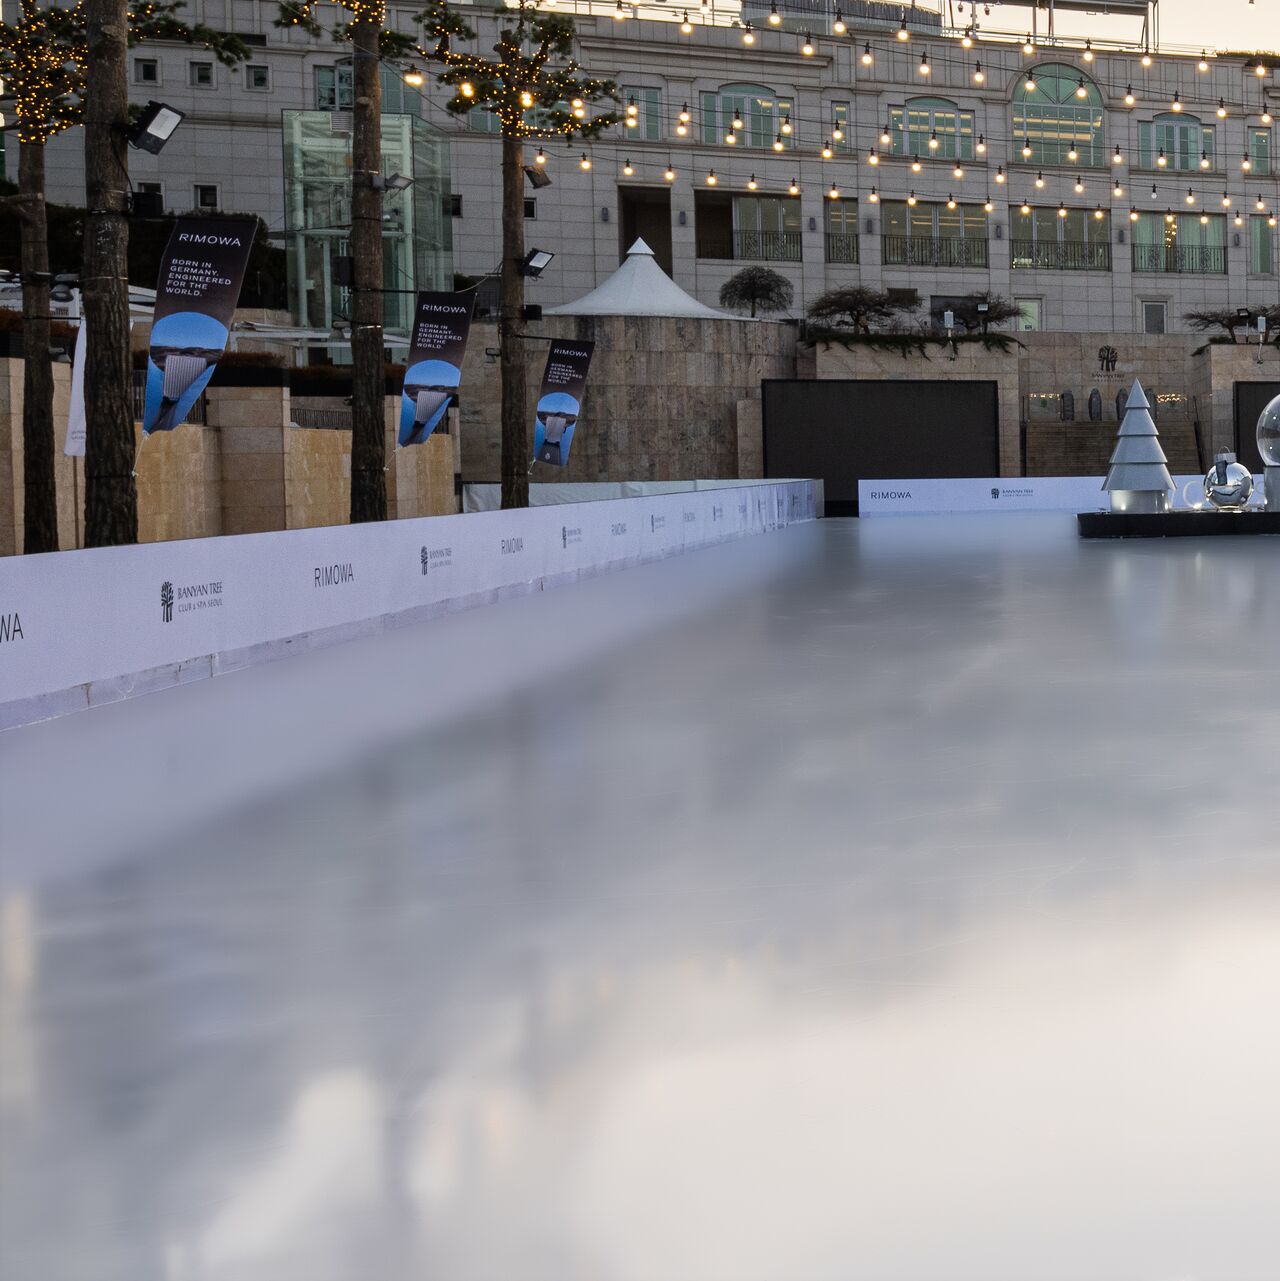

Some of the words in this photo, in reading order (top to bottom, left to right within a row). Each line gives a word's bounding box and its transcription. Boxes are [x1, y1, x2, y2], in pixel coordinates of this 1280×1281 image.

[179, 233, 241, 246] RIMOWA
[172, 258, 199, 267] BORN
[201, 261, 212, 269] IN
[170, 265, 219, 276] GERMANY.
[168, 272, 232, 285] ENGINEERED
[167, 279, 186, 287] FOR
[189, 282, 208, 290] THE
[165, 287, 203, 296] WORLD.
[422, 303, 467, 313] RIMOWA
[553, 348, 588, 358] RIMOWA
[870, 491, 912, 500] RIMOWA
[314, 564, 355, 588] RIMOWA
[177, 584, 209, 600] BANYAN
[209, 581, 223, 595] TREE
